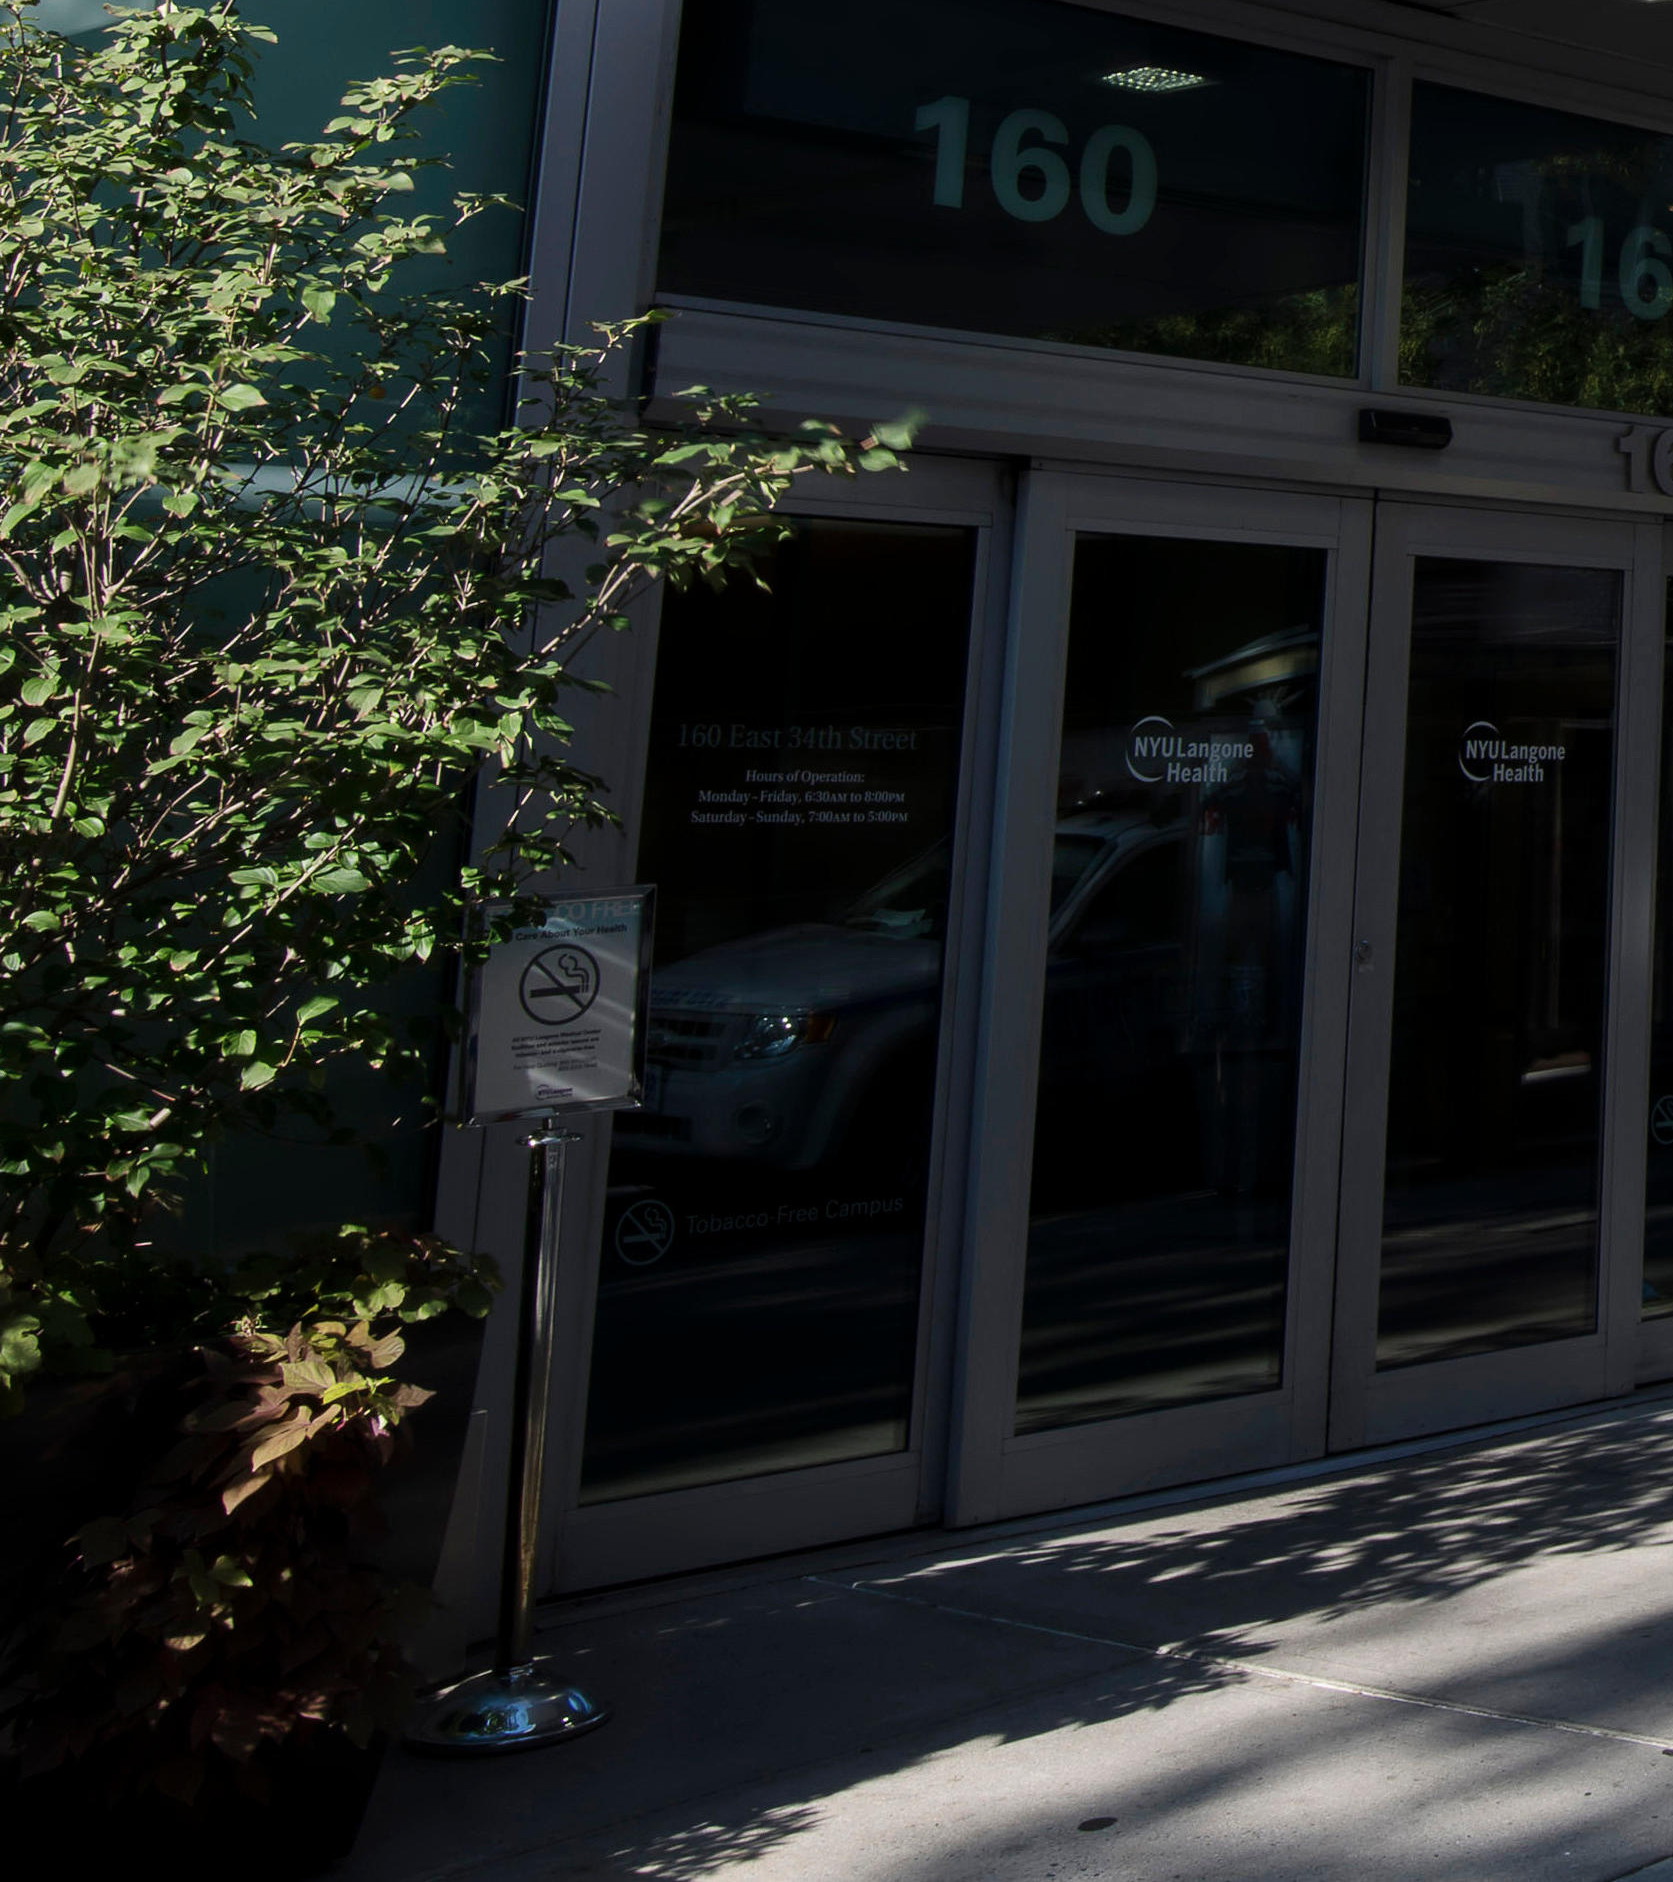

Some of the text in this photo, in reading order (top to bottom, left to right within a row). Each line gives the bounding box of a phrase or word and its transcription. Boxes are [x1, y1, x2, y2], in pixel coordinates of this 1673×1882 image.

[912, 94, 1159, 235] 160
[677, 722, 919, 750] 160 East 34th Street
[1134, 735, 1255, 765] NYU Langone
[1465, 739, 1567, 764] NYU Langone
[745, 769, 865, 785] Hours of Operation:
[1166, 761, 1229, 784] Health
[1493, 762, 1545, 784] Health
[849, 791, 862, 804] to
[852, 811, 865, 823] to
[515, 931, 537, 941] Care
[541, 929, 571, 940] About
[573, 926, 597, 937] Your
[684, 1196, 905, 1236] Tobacco-Free Campus
